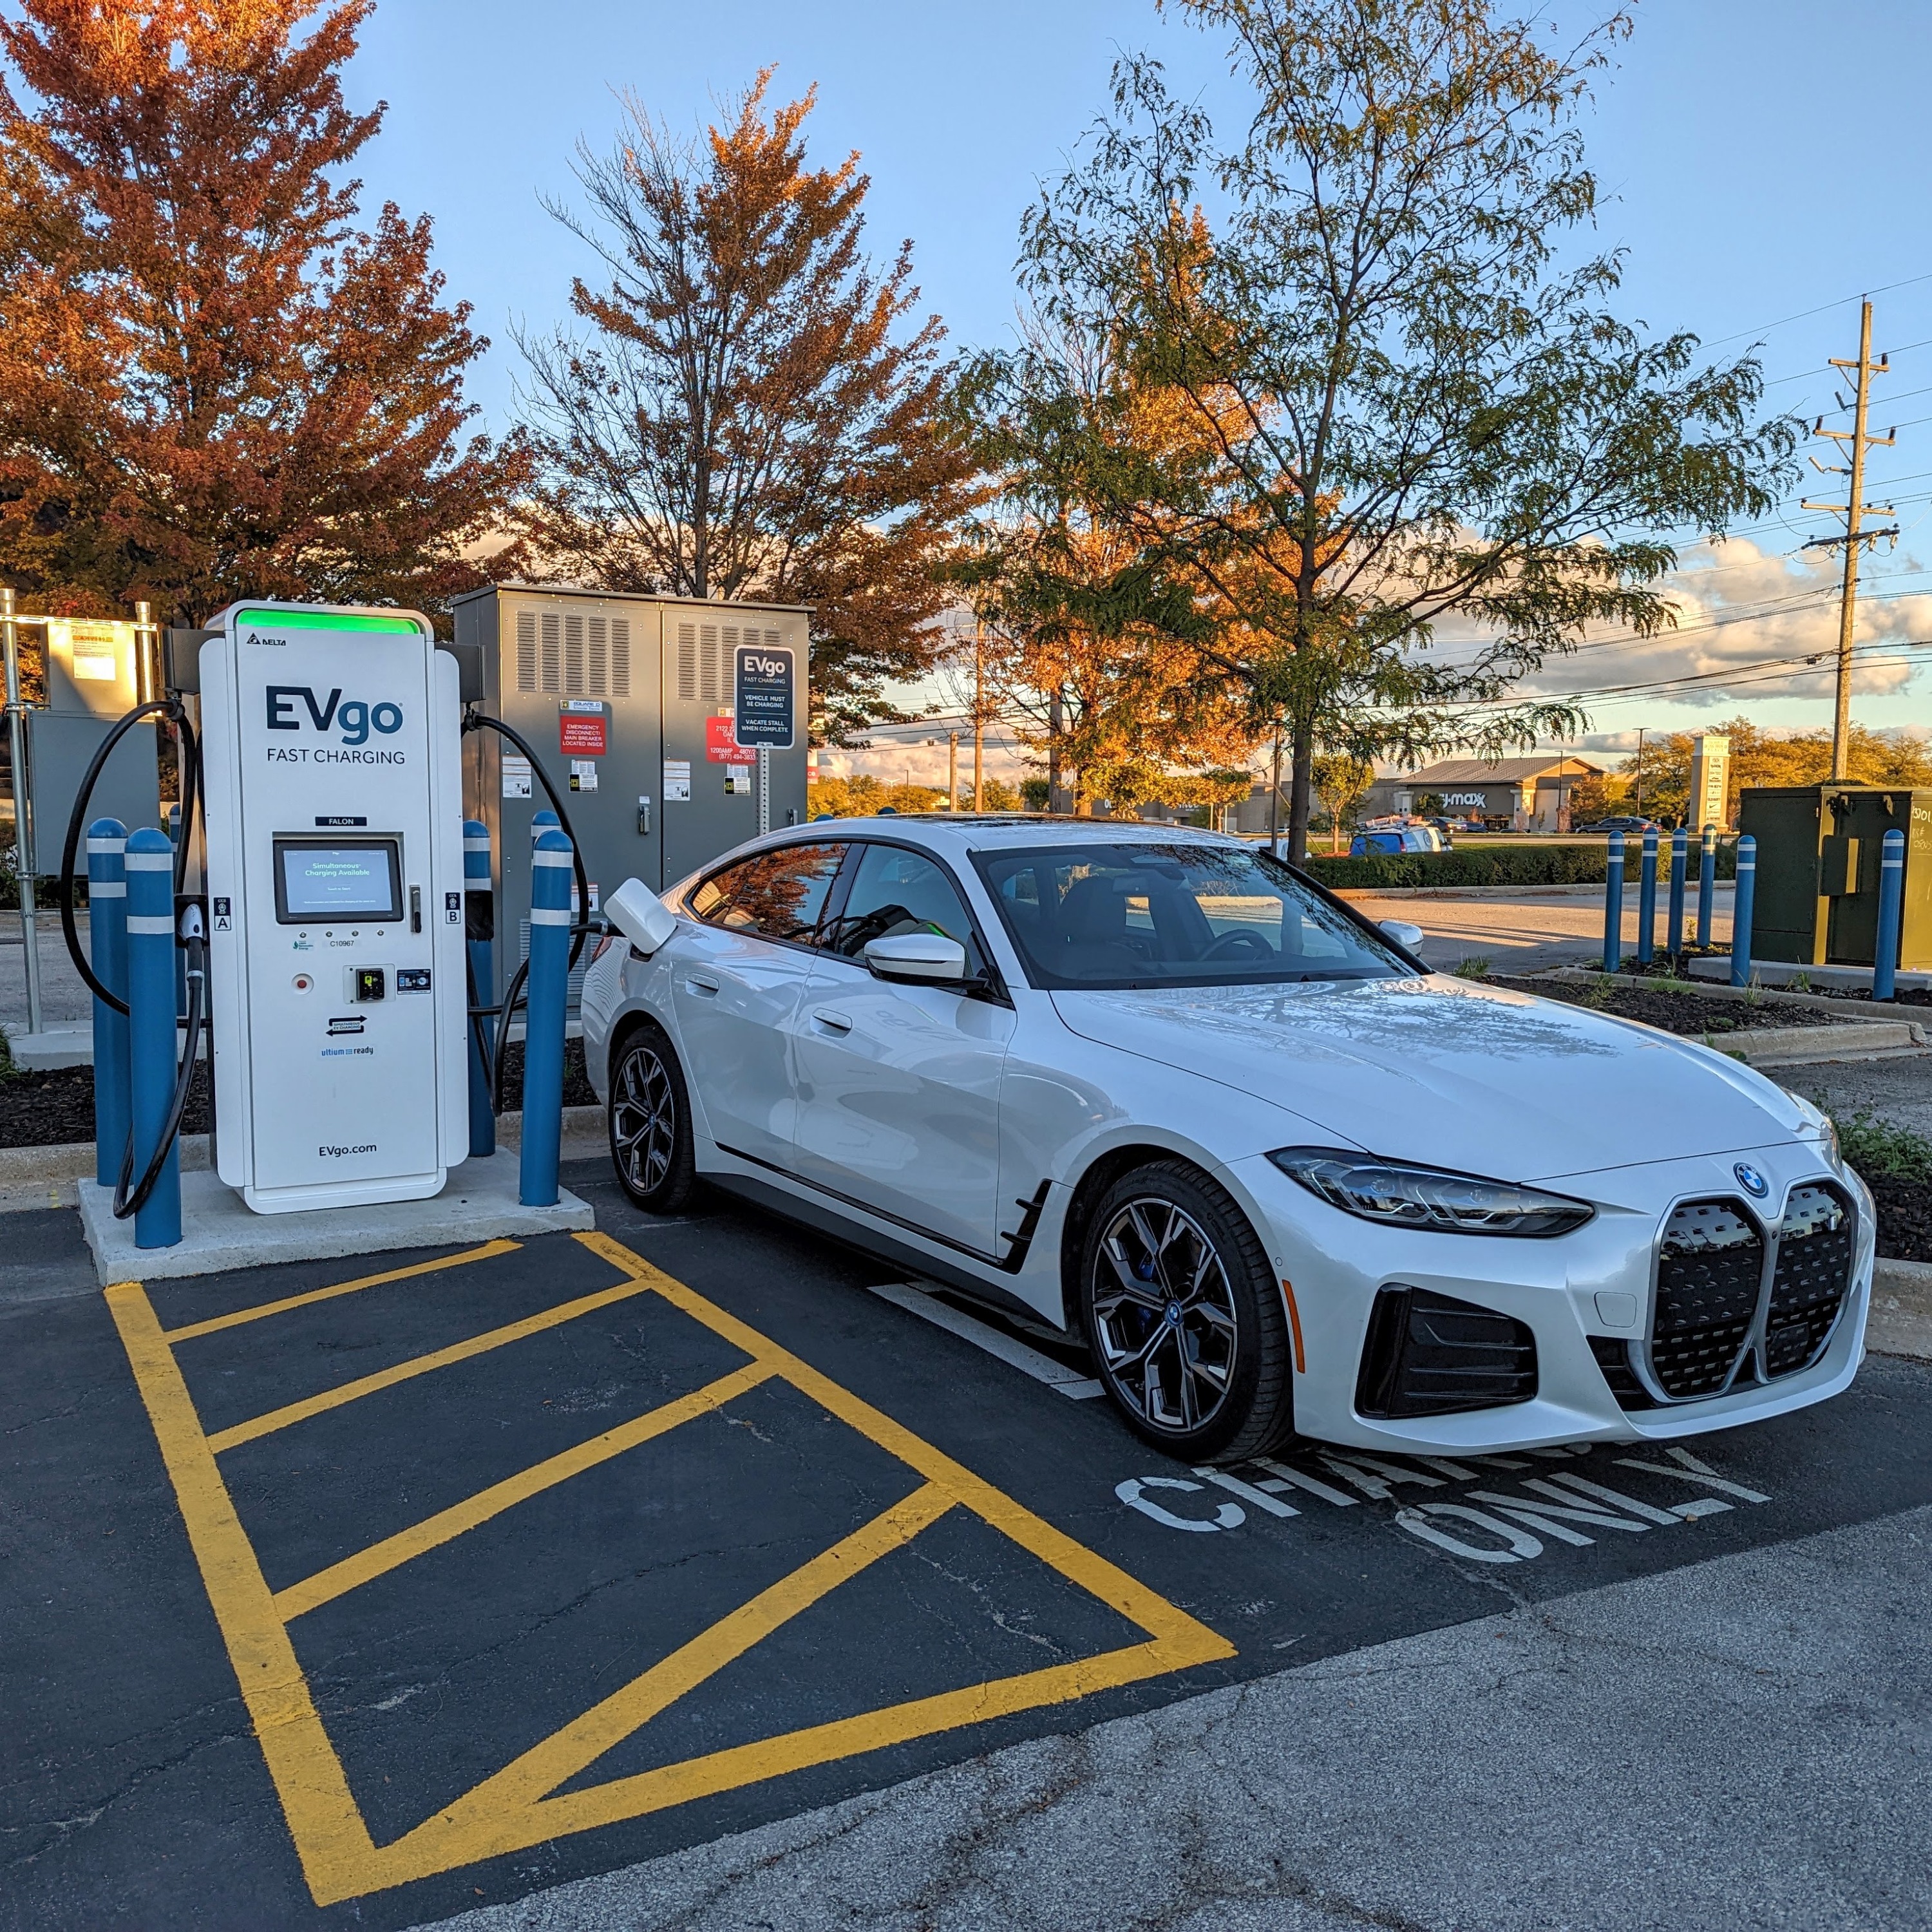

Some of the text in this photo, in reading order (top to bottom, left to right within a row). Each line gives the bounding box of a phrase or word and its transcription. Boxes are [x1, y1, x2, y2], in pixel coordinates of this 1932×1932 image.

[744, 656, 786, 677] EVgo
[266, 685, 403, 746] EVgo
[267, 748, 406, 764] FAST CHARGING
[218, 917, 229, 929] A
[450, 911, 457, 922] B
[321, 1046, 374, 1056] ultium ready
[319, 1144, 377, 1158] EVgo.com
[1394, 1445, 1774, 1564] ONLY
